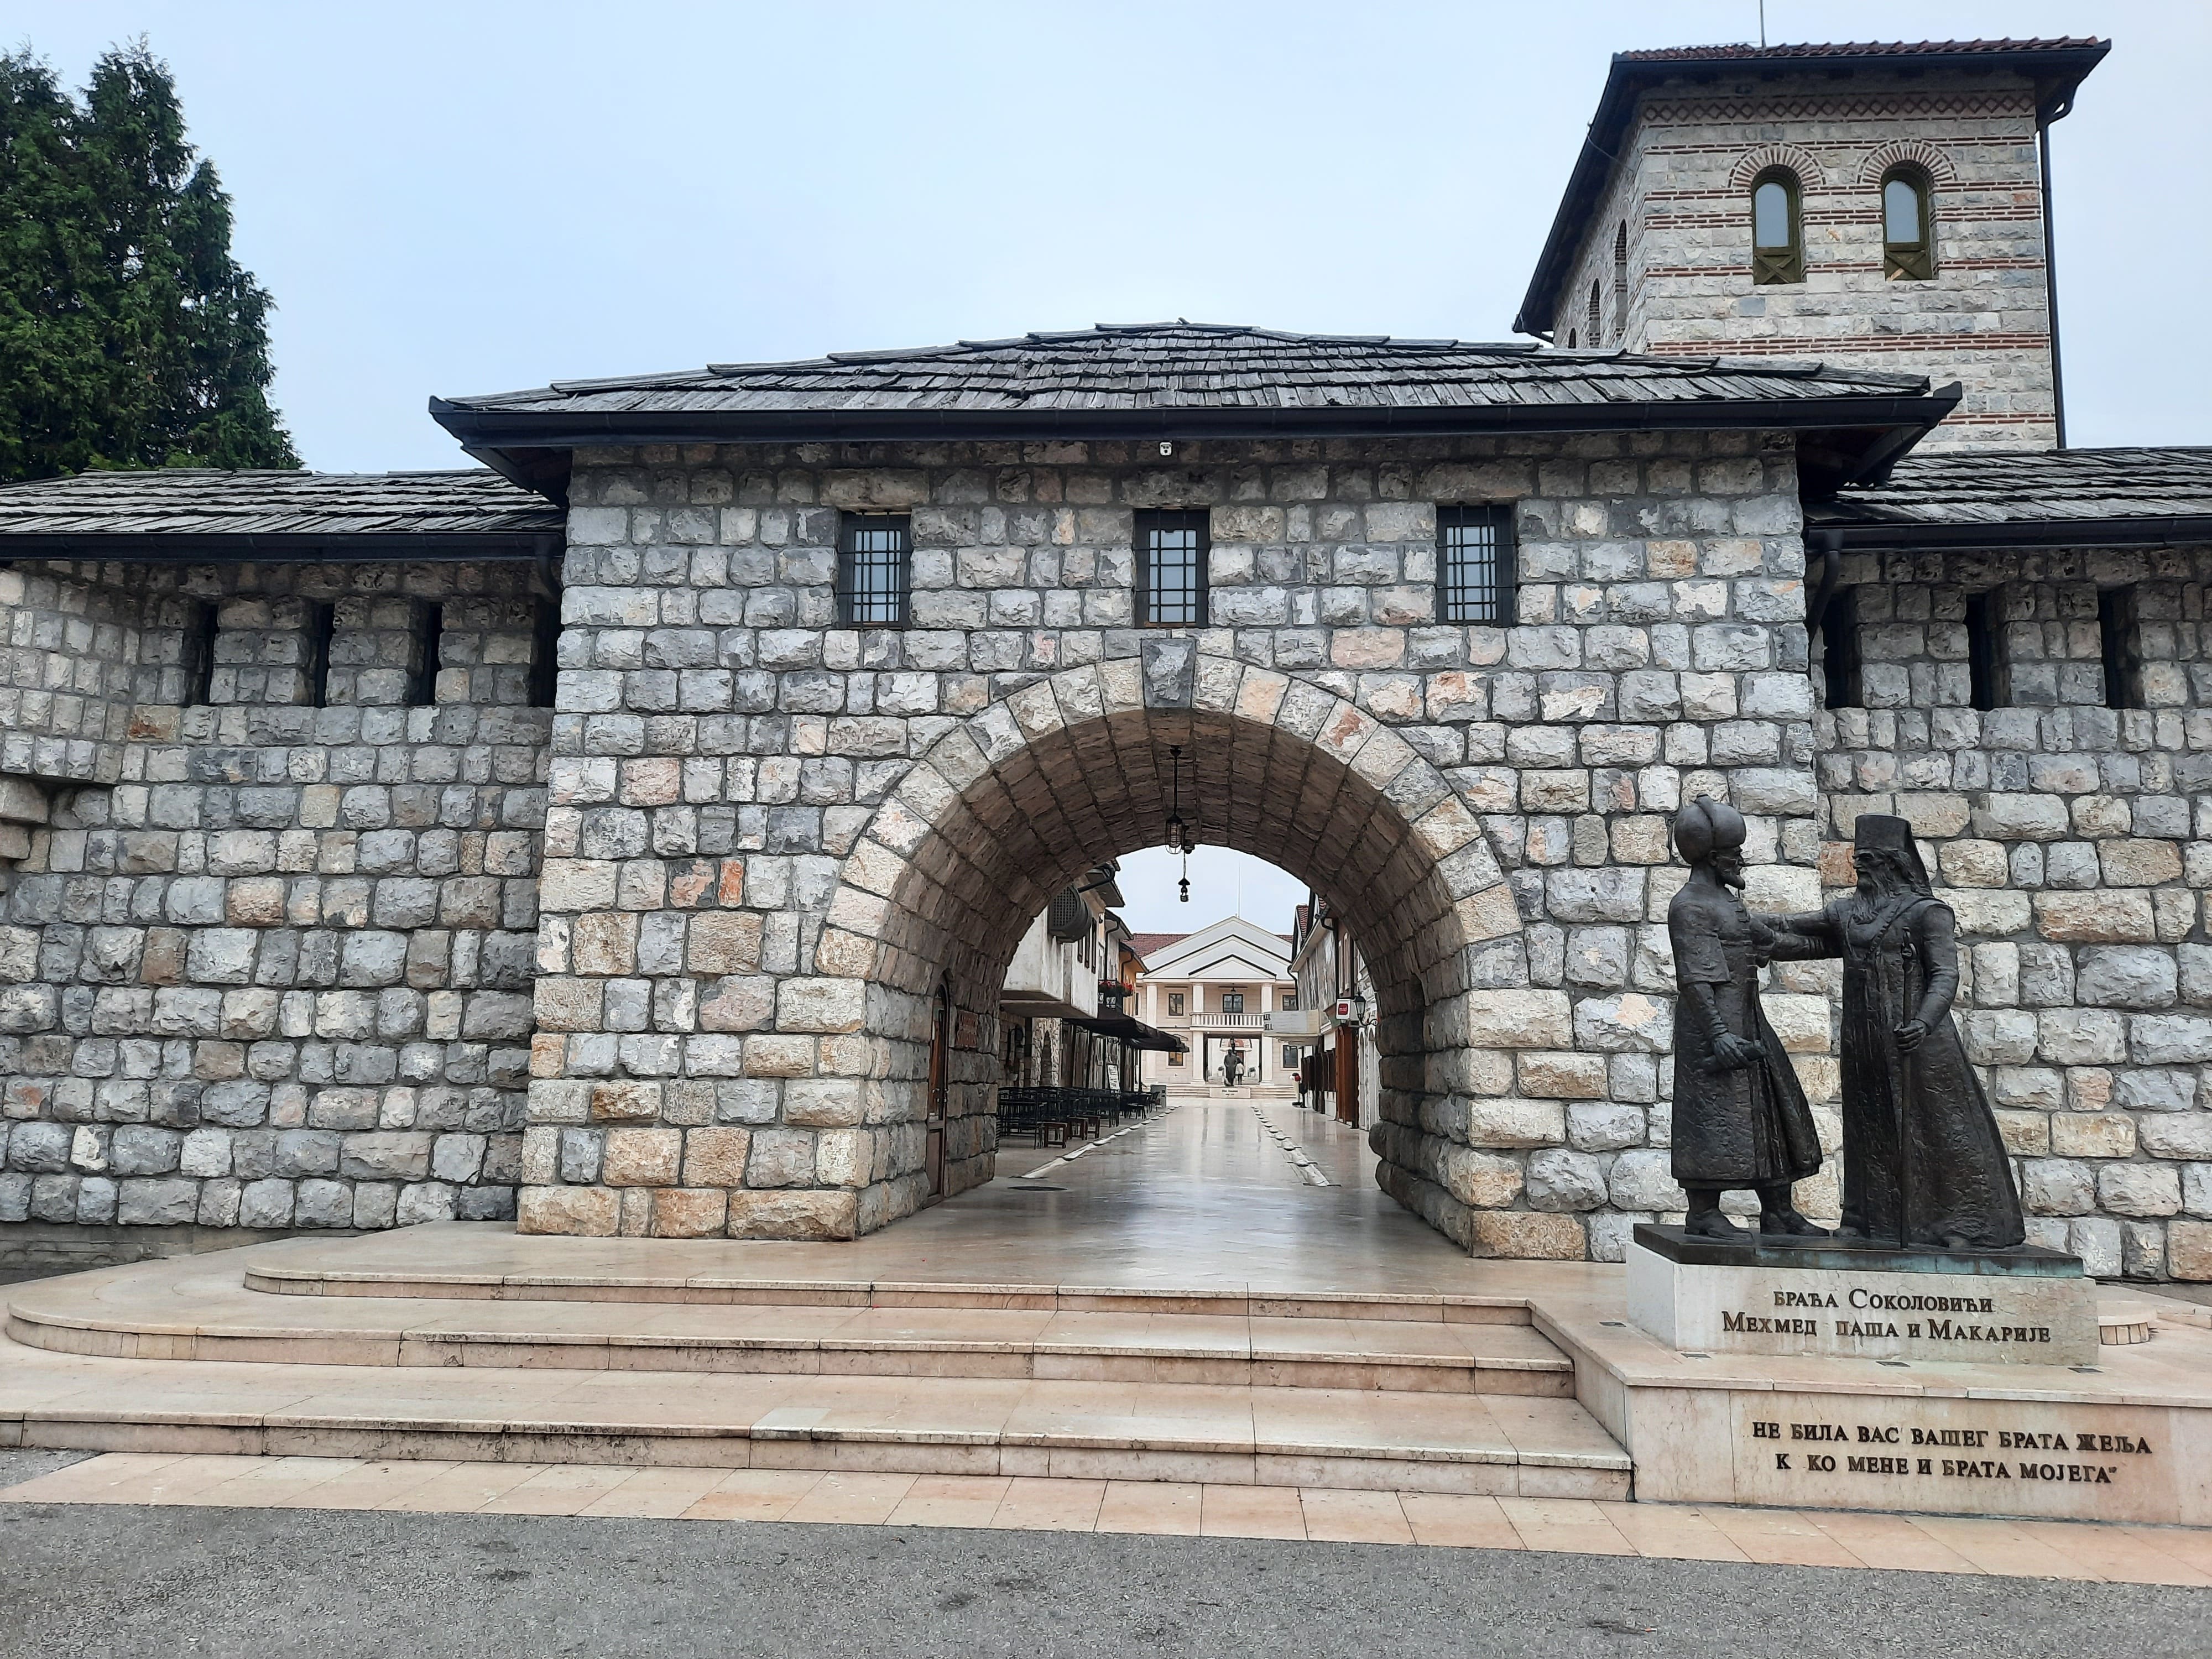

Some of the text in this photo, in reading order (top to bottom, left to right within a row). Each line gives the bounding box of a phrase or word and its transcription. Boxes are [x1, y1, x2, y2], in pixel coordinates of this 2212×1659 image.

[1773, 1291, 1839, 1307] БРАЋА
[1721, 1311, 2051, 1343] МЕХМЕД ПАША И МАКАРИЈЕ
[1752, 1422, 2152, 1453] НЕ БИЛА ВАС ВАШЕГ БРАТА ЖЕЉА
[1775, 1453, 1791, 1469] К
[1807, 1454, 1837, 1472] КО
[1847, 1456, 1909, 1474] МЕНЕ
[1917, 1459, 1932, 1475] И
[1942, 1459, 2011, 1478] БРАТА
